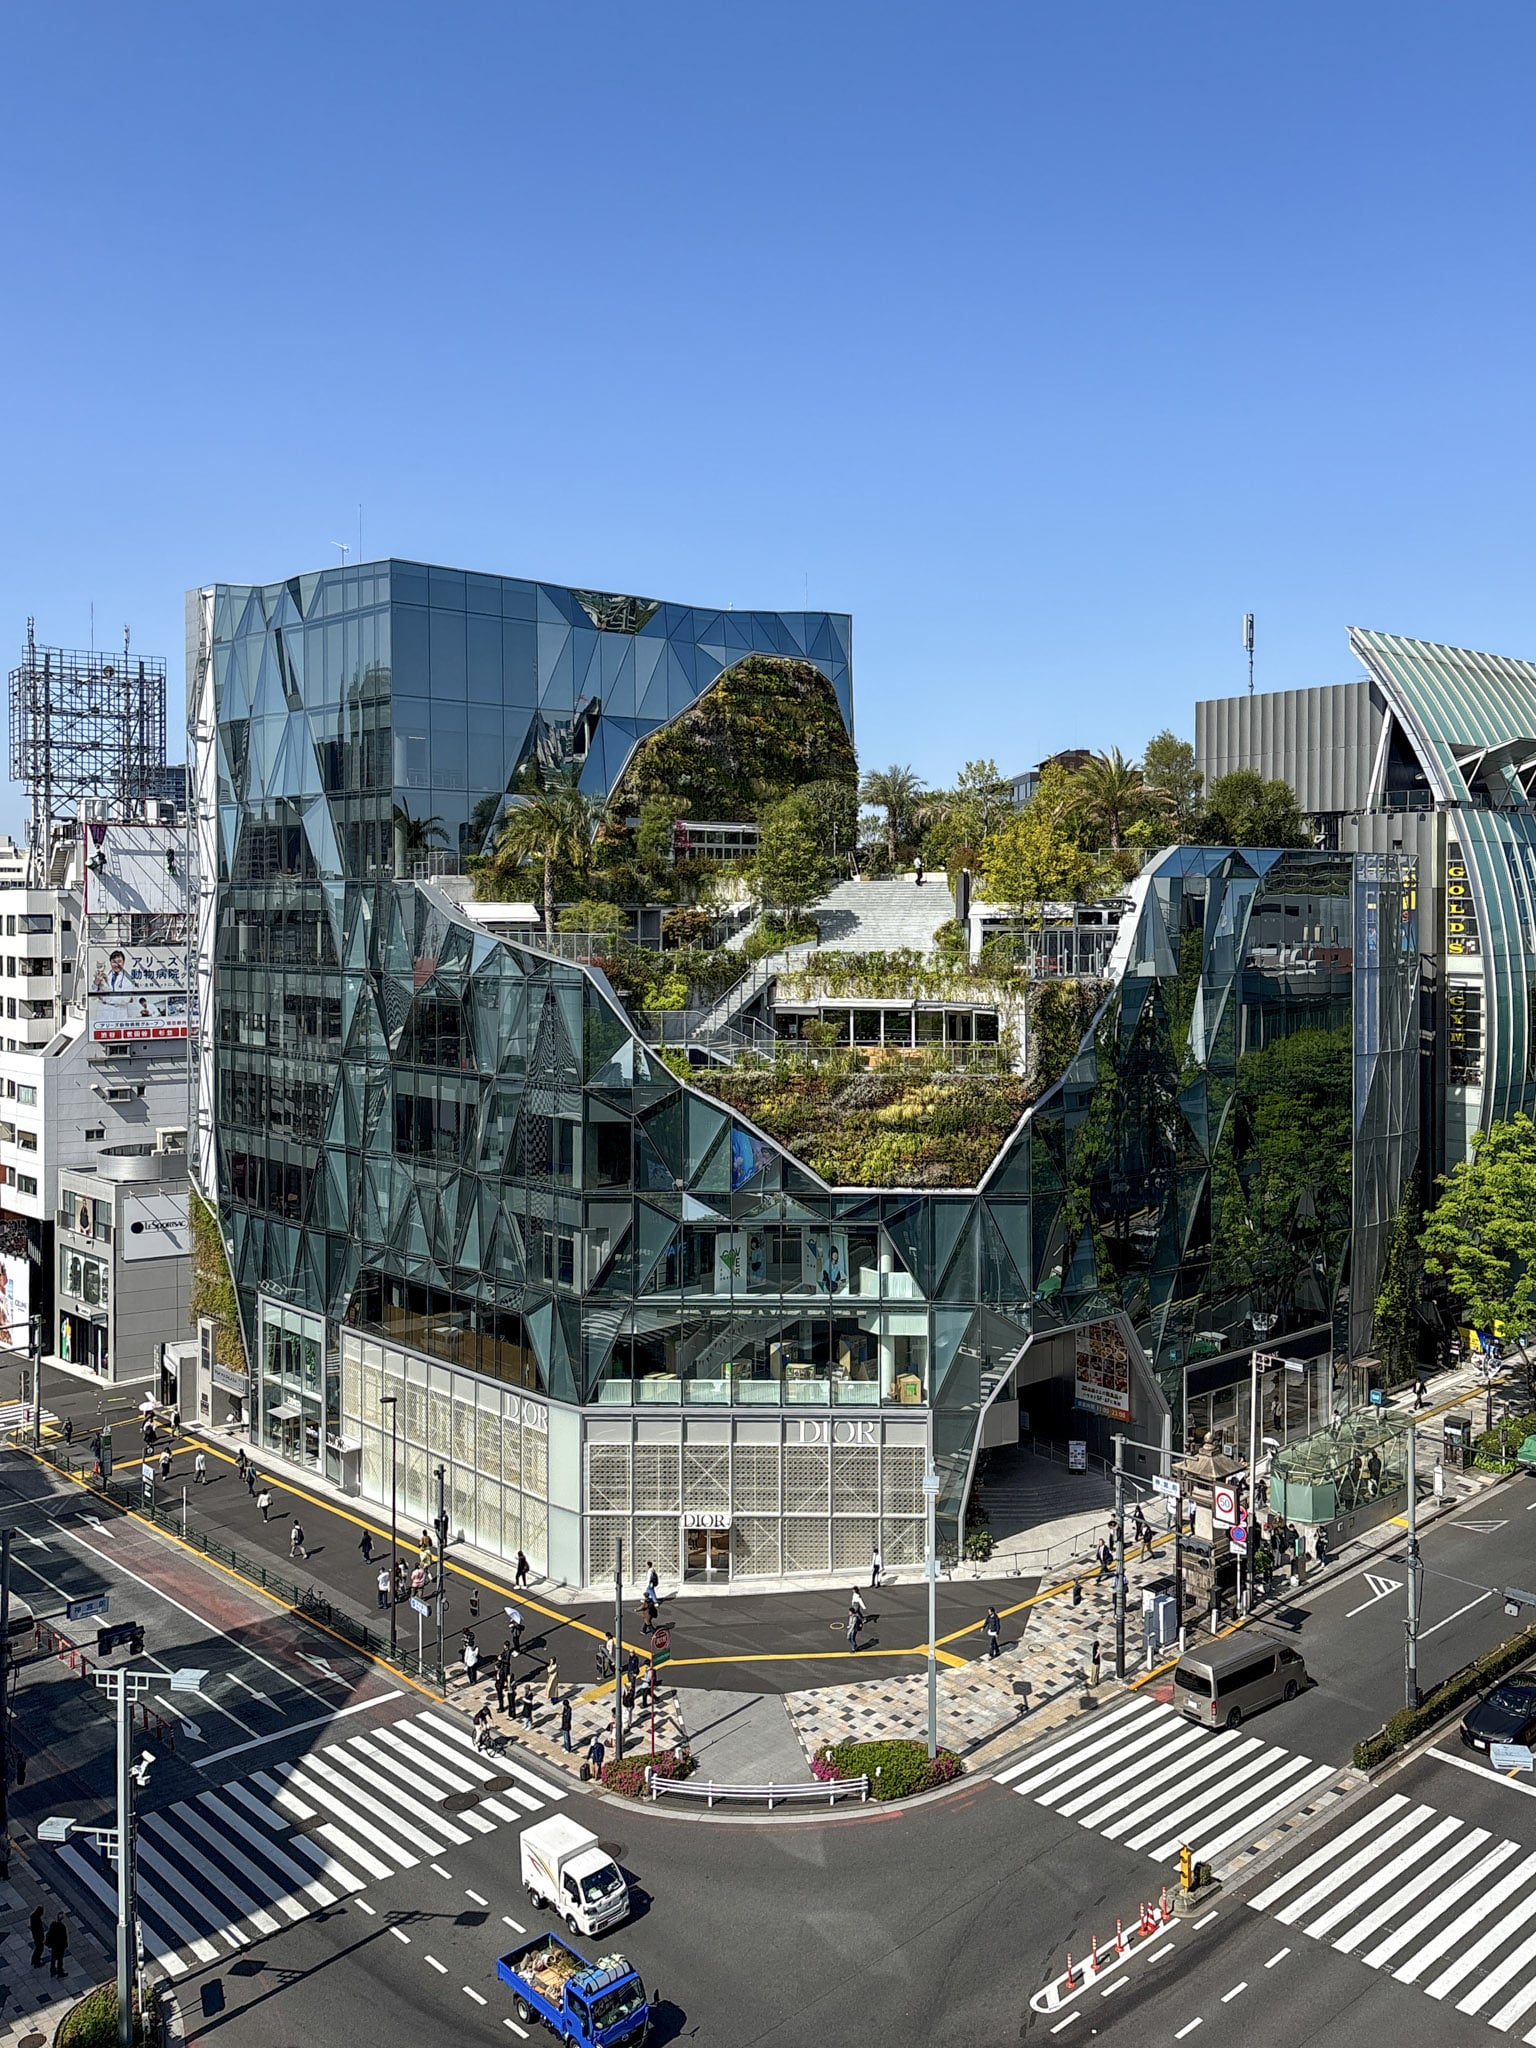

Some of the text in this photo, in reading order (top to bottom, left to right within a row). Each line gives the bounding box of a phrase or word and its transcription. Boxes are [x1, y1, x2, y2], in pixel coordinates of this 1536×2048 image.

[131, 956, 178, 968] アリーズ
[131, 968, 179, 980] 動物病院
[1449, 996, 1465, 1042] GYM
[798, 1420, 877, 1444] DIOR
[1219, 1497, 1230, 1508] 50
[684, 1514, 726, 1528] DIOR
